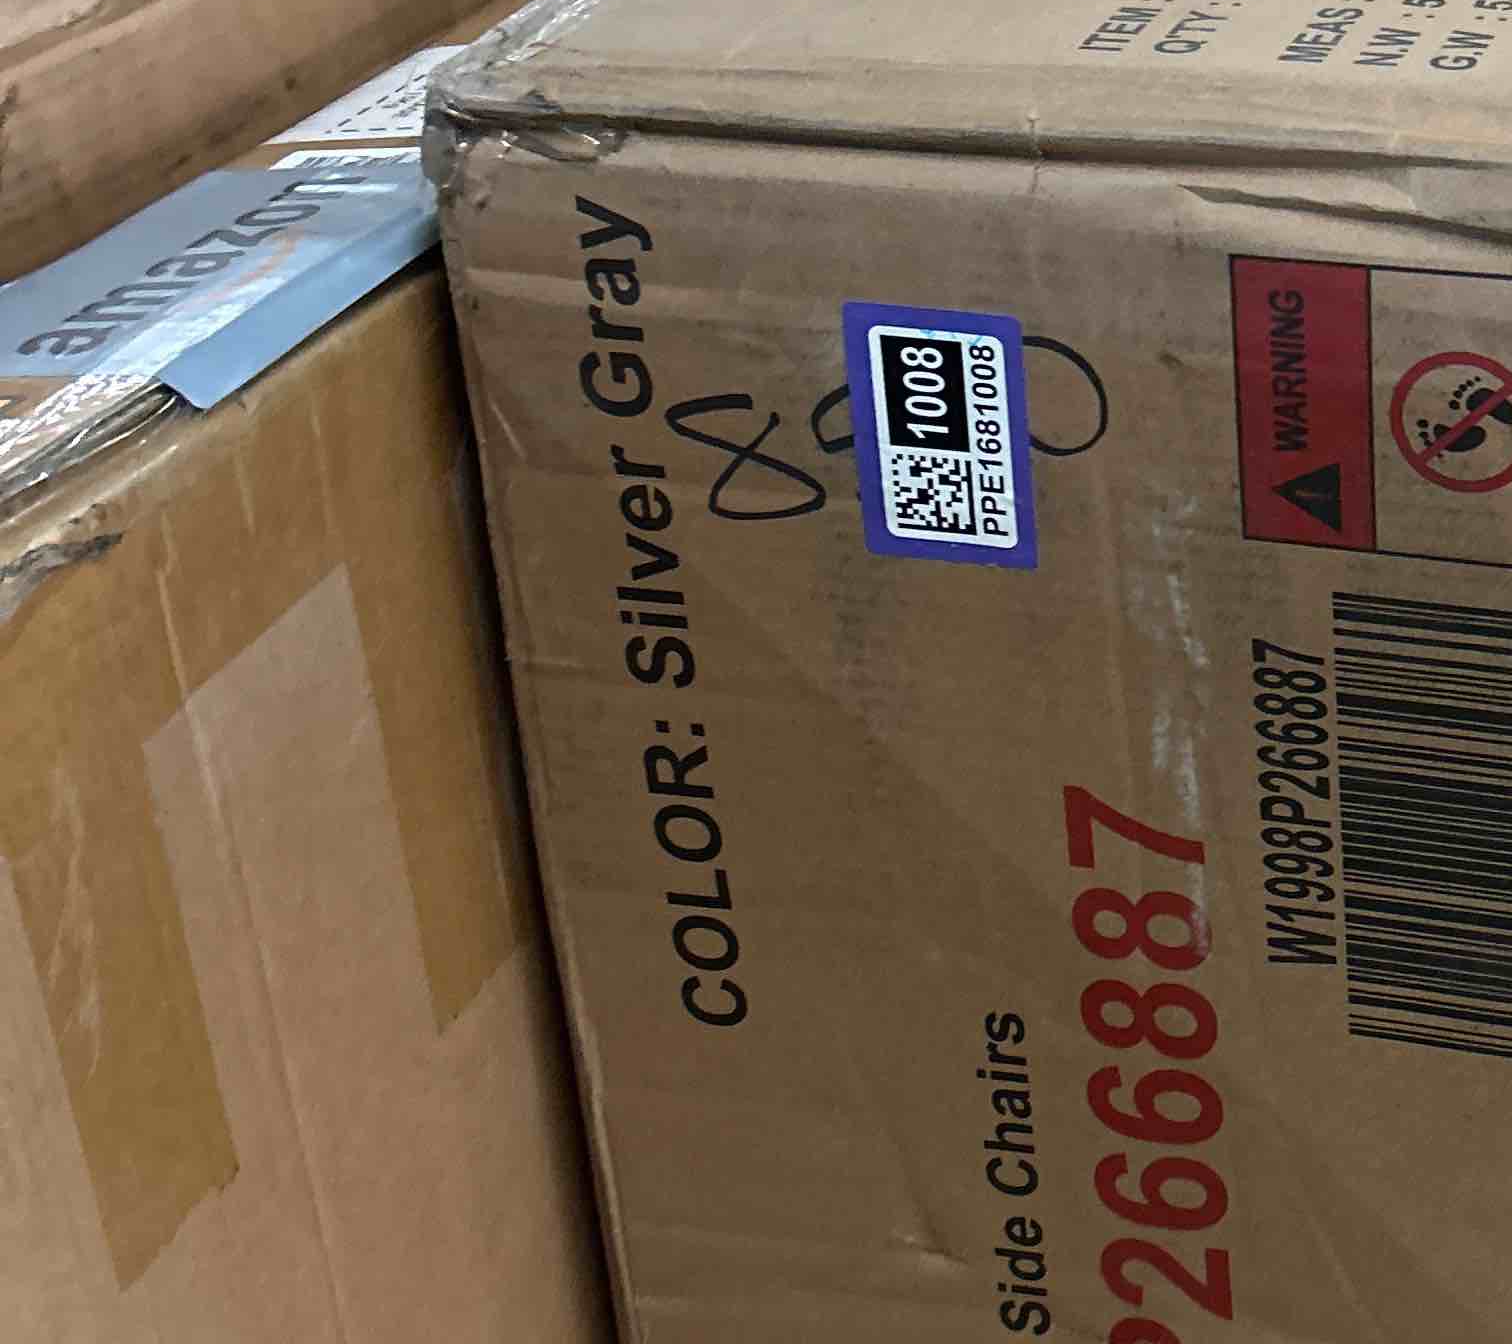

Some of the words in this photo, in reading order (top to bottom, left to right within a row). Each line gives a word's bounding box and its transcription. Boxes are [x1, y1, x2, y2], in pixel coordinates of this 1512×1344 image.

[1078, 7, 1163, 51] ITEM
[1278, 8, 1364, 63] MEAS
[1354, 27, 1421, 66] N.W
[1429, 30, 1495, 71] G.W
[575, 195, 653, 416] Gray
[1268, 289, 1307, 452] WARNING
[900, 346, 949, 440] 1008
[969, 344, 1009, 537] PPE1681008
[615, 446, 694, 688] Silver
[644, 718, 748, 1027] COLOR:
[1252, 638, 1337, 965] W1998P266887
[976, 1011, 1039, 1197] Chairs
[995, 1216, 1051, 1336] Side
